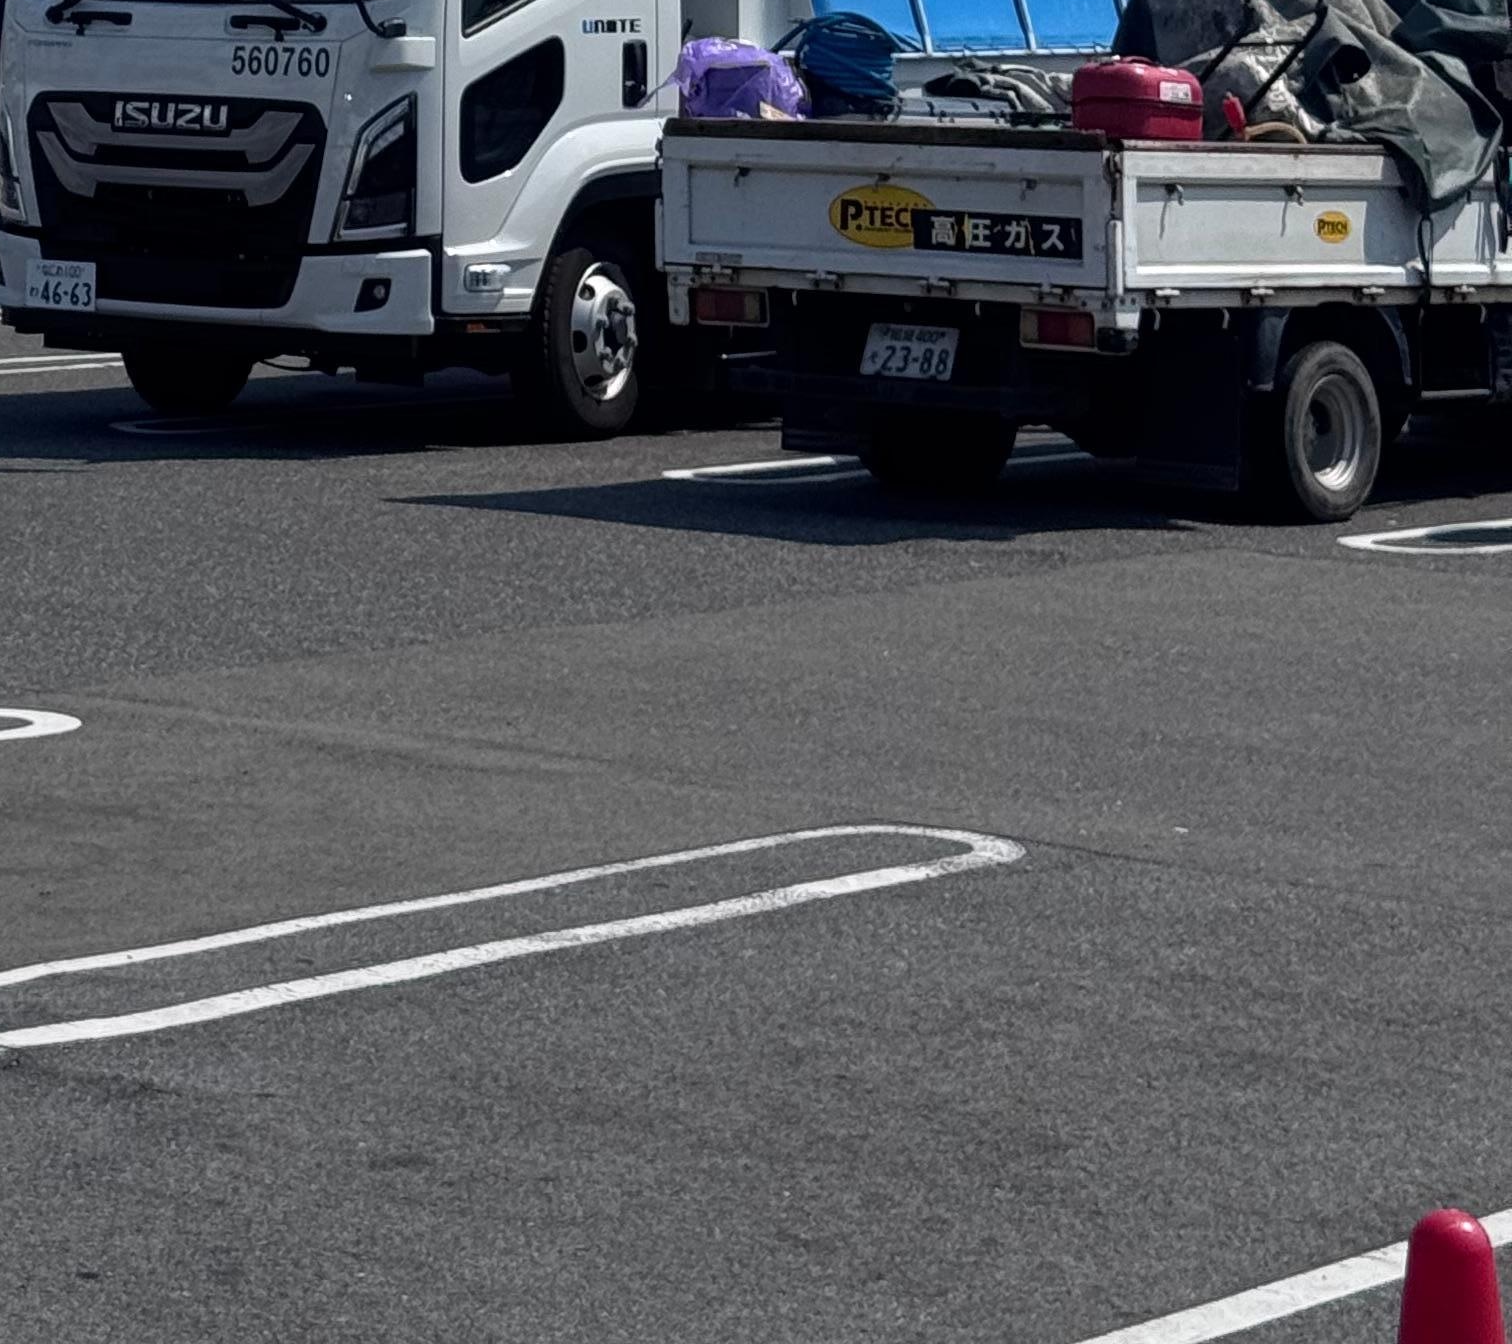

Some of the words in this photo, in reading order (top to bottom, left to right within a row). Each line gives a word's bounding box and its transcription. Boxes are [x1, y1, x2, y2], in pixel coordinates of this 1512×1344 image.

[231, 46, 331, 78] 560760
[114, 100, 229, 130] ISUZU
[839, 199, 913, 231] P.TEC
[930, 214, 1065, 252] 高圧ガス
[880, 345, 950, 375] 23-88
